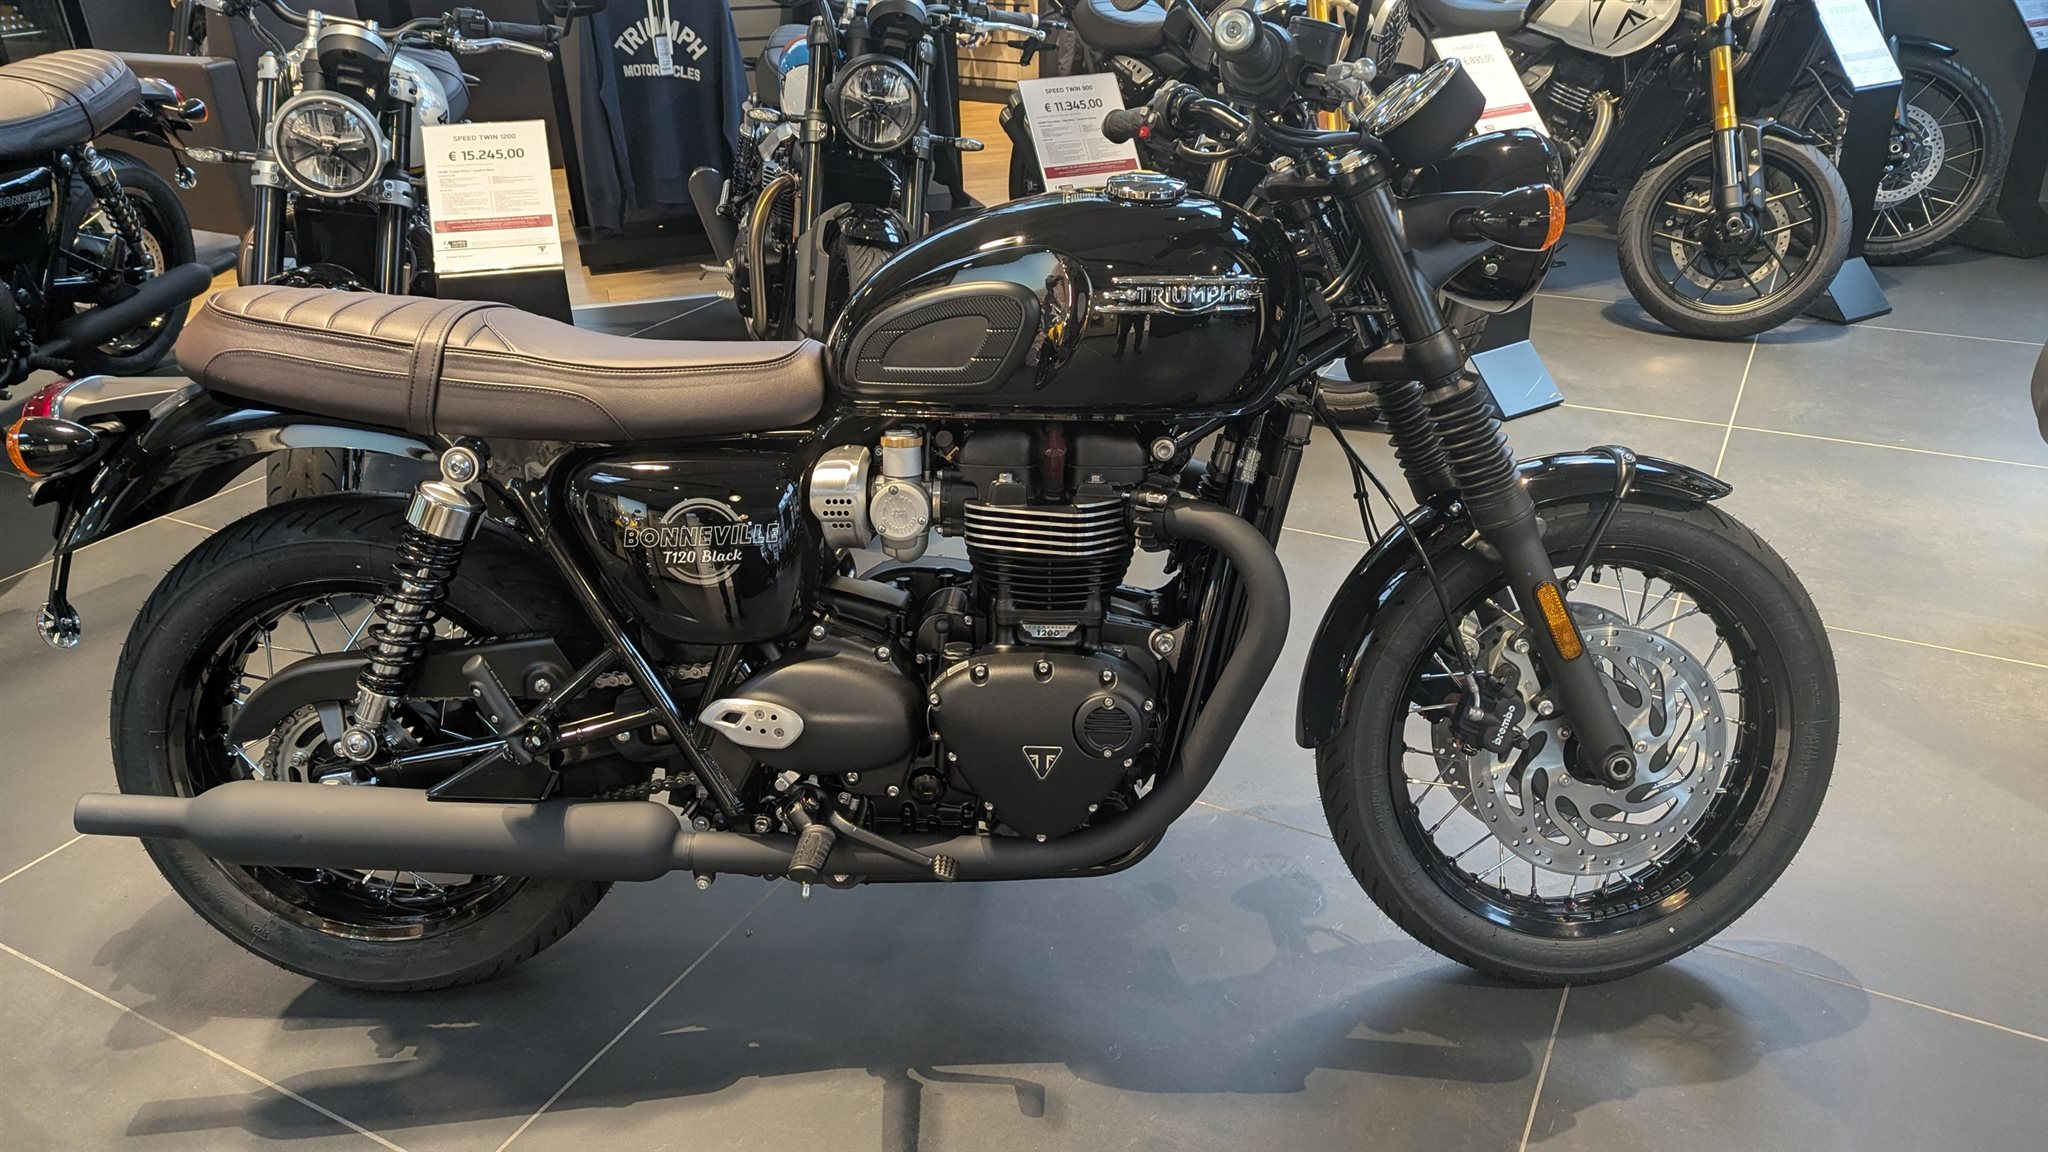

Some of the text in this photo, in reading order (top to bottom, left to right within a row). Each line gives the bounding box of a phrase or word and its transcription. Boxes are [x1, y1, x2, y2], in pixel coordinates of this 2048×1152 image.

[613, 16, 708, 61] TRIUMPH
[622, 63, 701, 82] MOTORCLES
[1045, 87, 1064, 95] SPEED
[1044, 98, 1103, 113] € 11.345,00
[448, 148, 525, 162] € 15.245,00
[1136, 285, 1237, 305] TRIUMPH
[623, 522, 780, 548] BONNEVILLE
[663, 549, 743, 564] T120 Black
[1036, 629, 1060, 637] 1200
[1491, 704, 1516, 746] brembo
